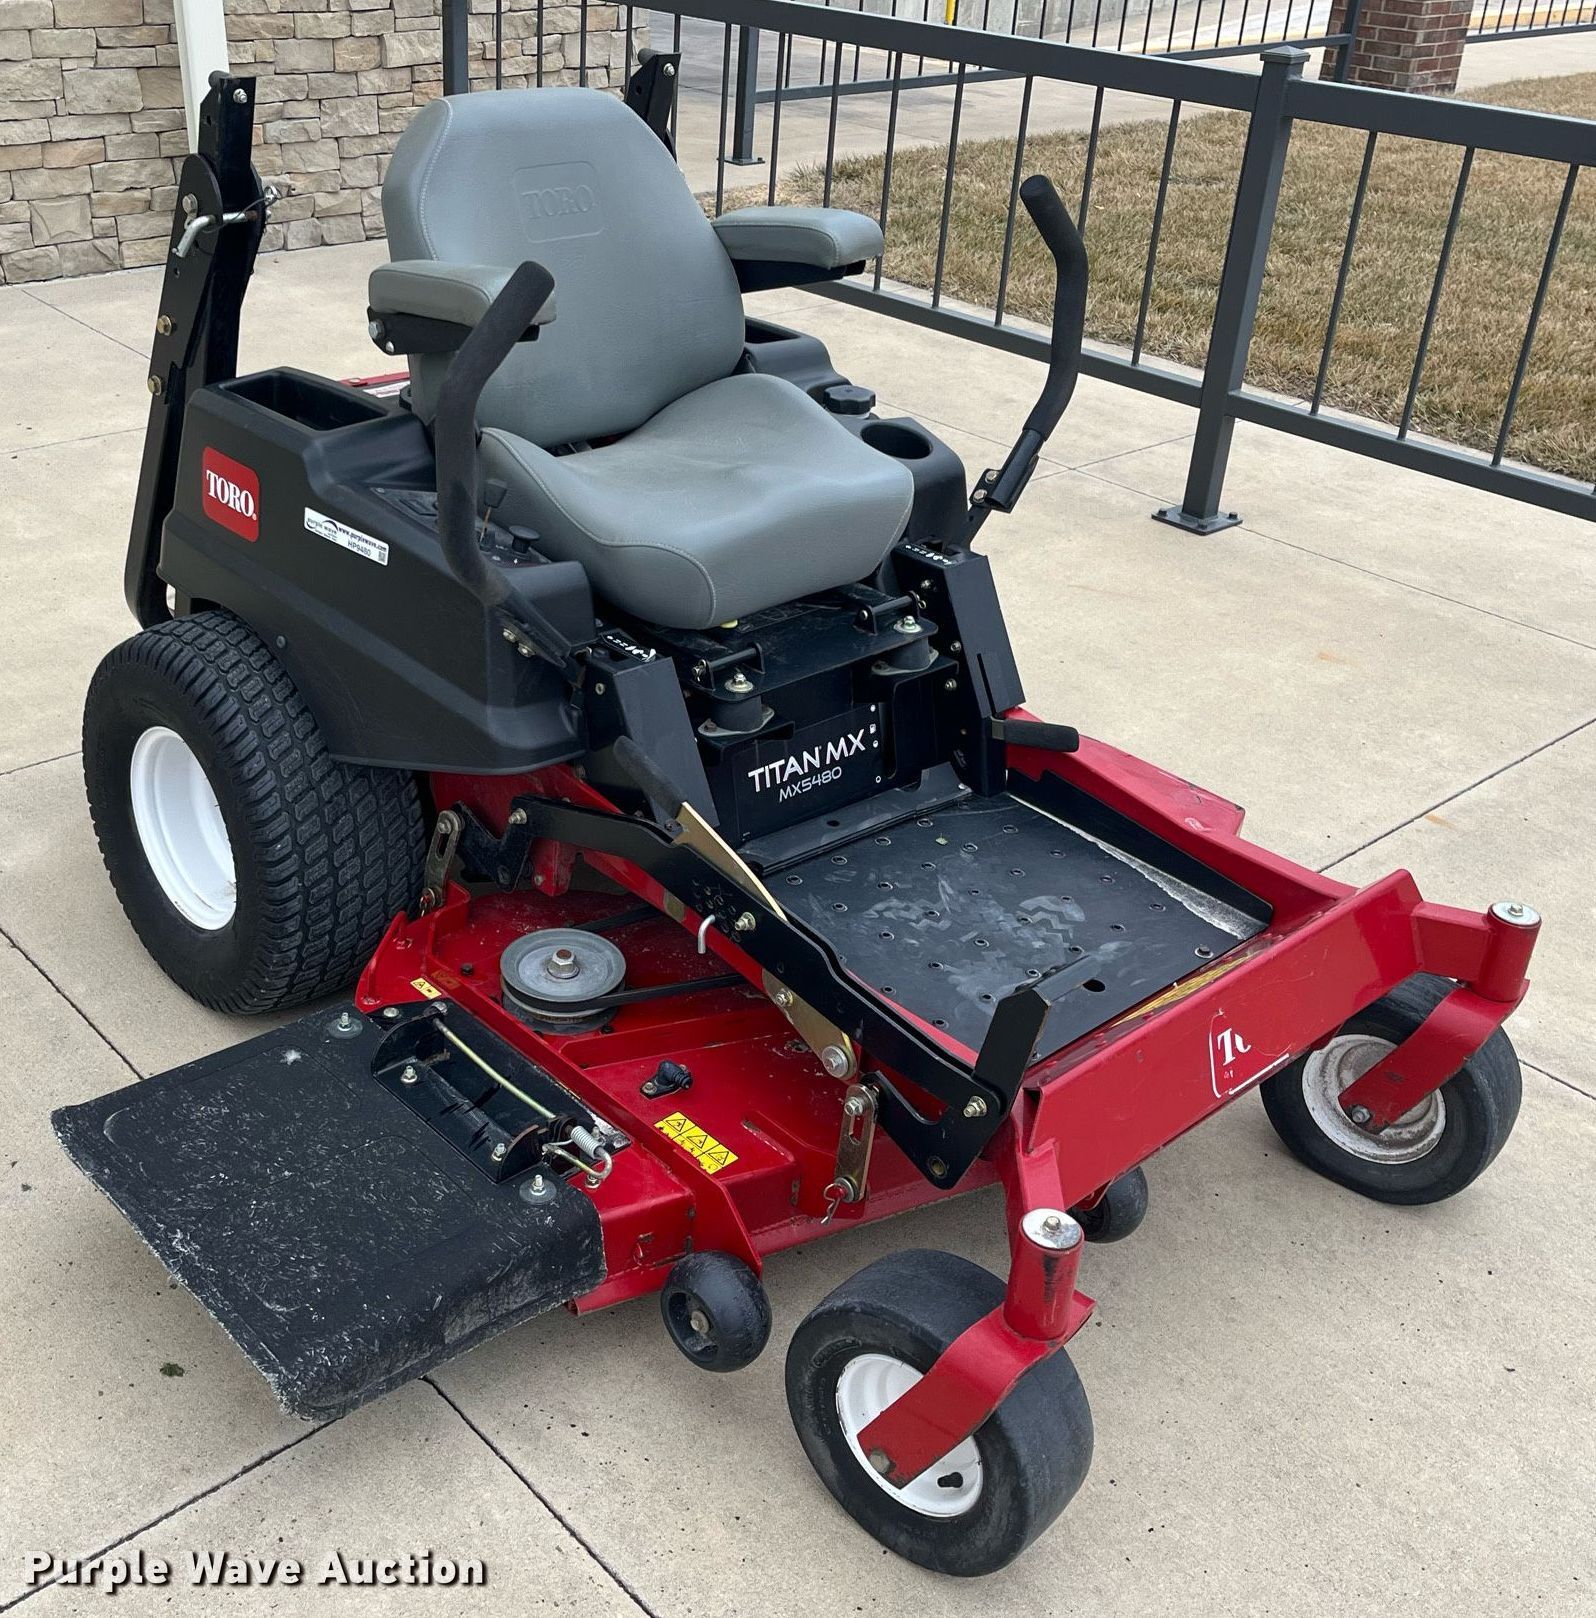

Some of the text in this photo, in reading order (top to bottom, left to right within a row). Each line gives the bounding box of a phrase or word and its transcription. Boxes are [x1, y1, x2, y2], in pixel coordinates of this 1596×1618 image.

[338, 526, 387, 552] www.purplewave.com
[747, 728, 866, 793] TITAN MX
[779, 766, 842, 803] MX5480
